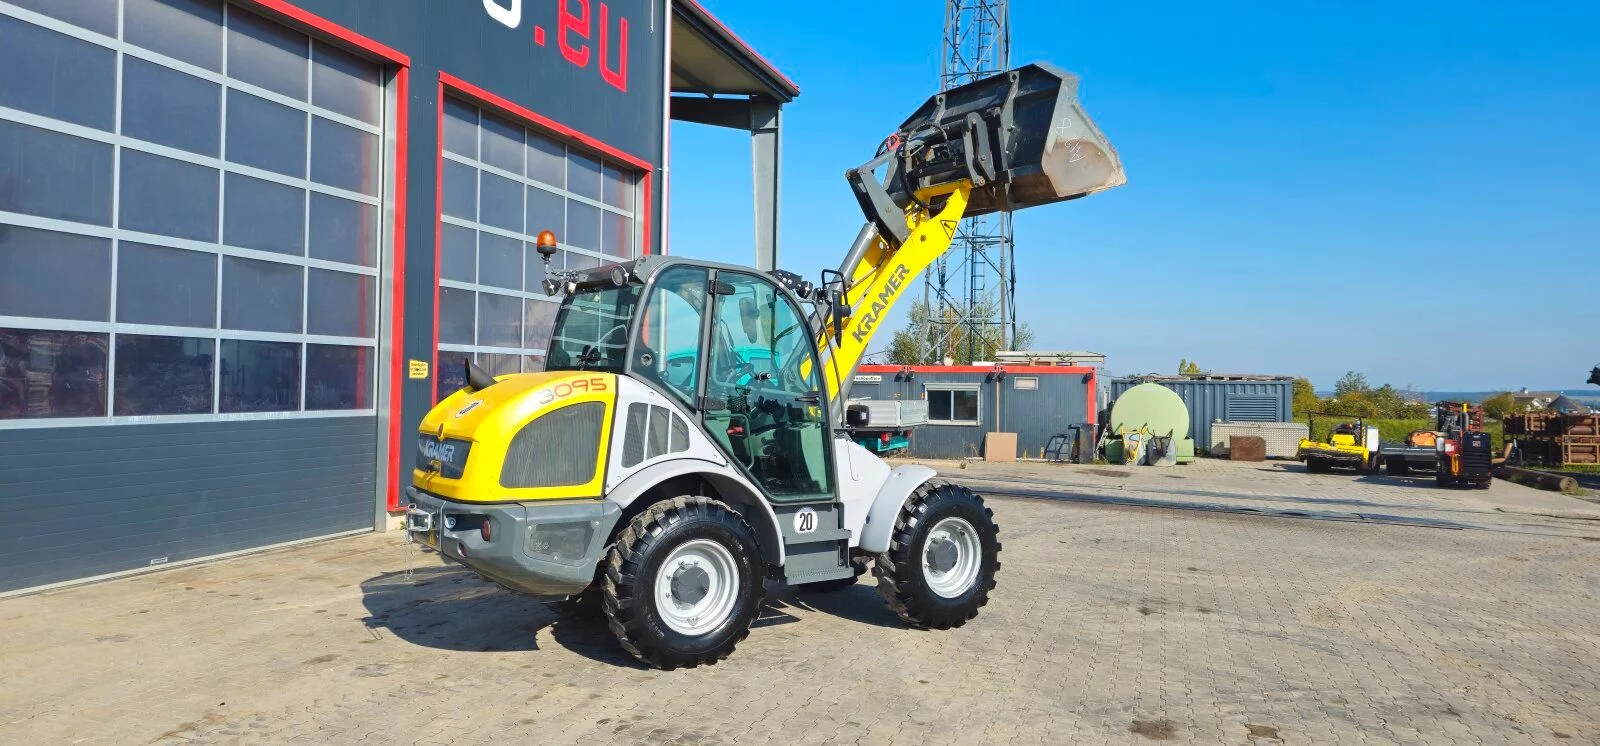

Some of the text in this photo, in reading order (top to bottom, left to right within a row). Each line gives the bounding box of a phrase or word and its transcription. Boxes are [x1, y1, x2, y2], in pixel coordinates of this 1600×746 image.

[852, 263, 910, 343] KRAMER
[537, 377, 607, 404] 3095
[423, 440, 455, 462] KRAMER
[799, 512, 813, 532] 20
